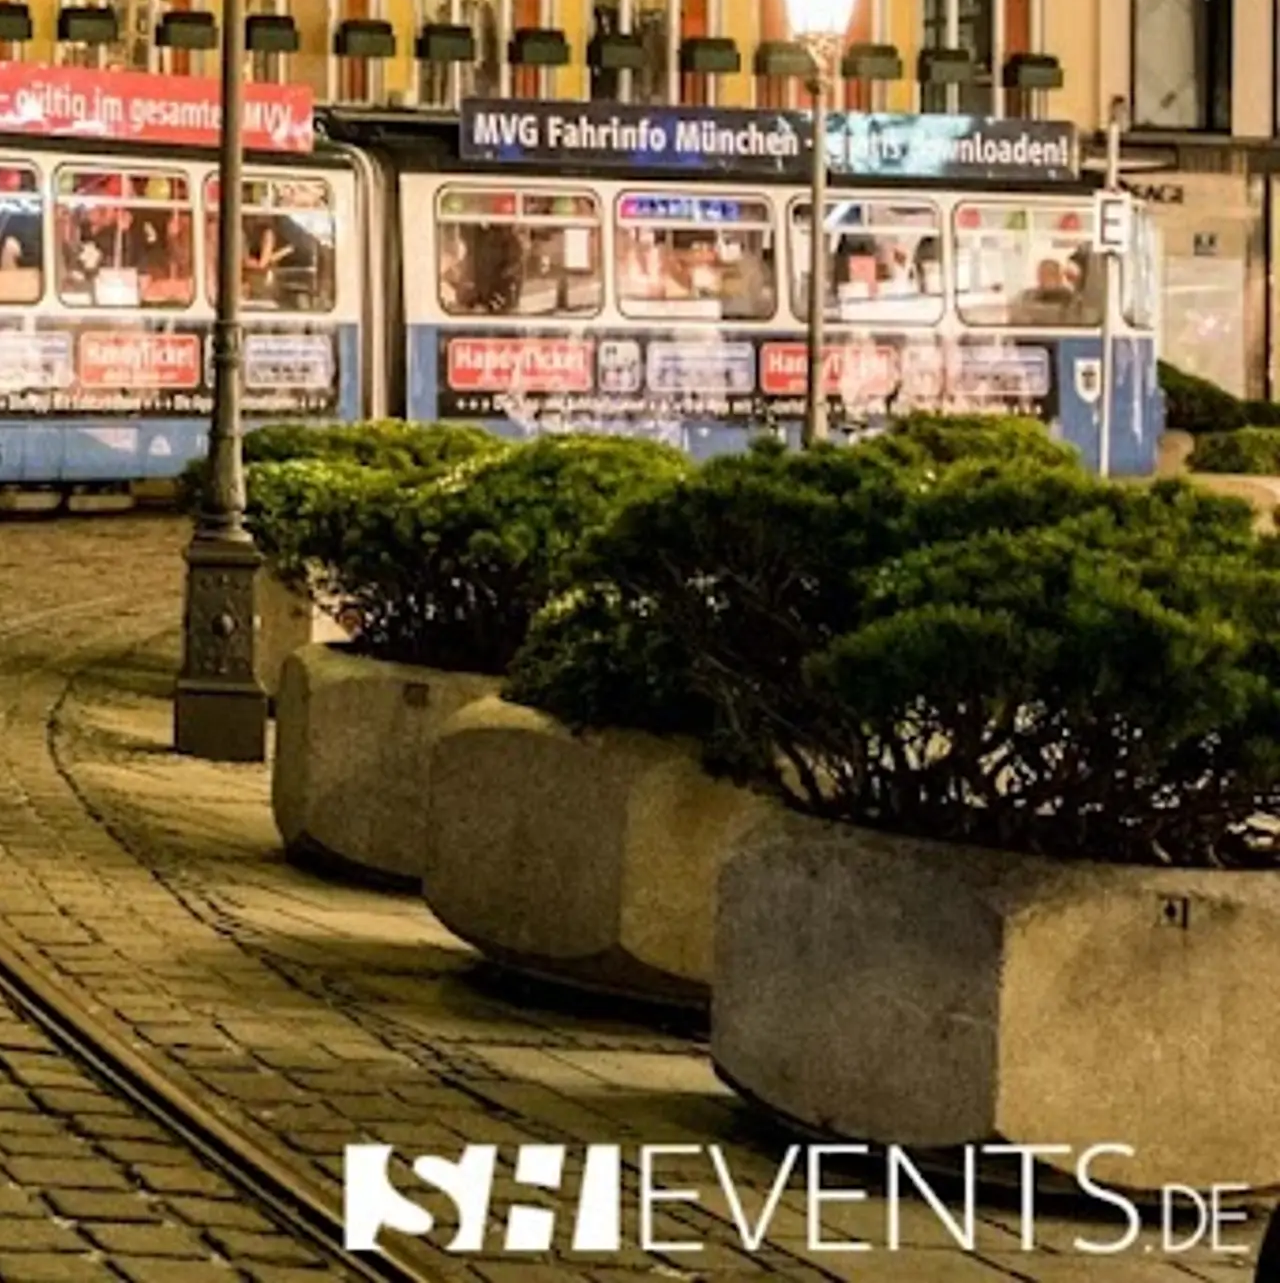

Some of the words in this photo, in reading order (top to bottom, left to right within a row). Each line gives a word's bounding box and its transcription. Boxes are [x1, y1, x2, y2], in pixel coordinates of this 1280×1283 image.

[129, 96, 224, 133] gesamte
[472, 114, 539, 147] MVG
[547, 116, 667, 152] Fahrinfo
[674, 119, 800, 157] München
[1100, 199, 1123, 245] E
